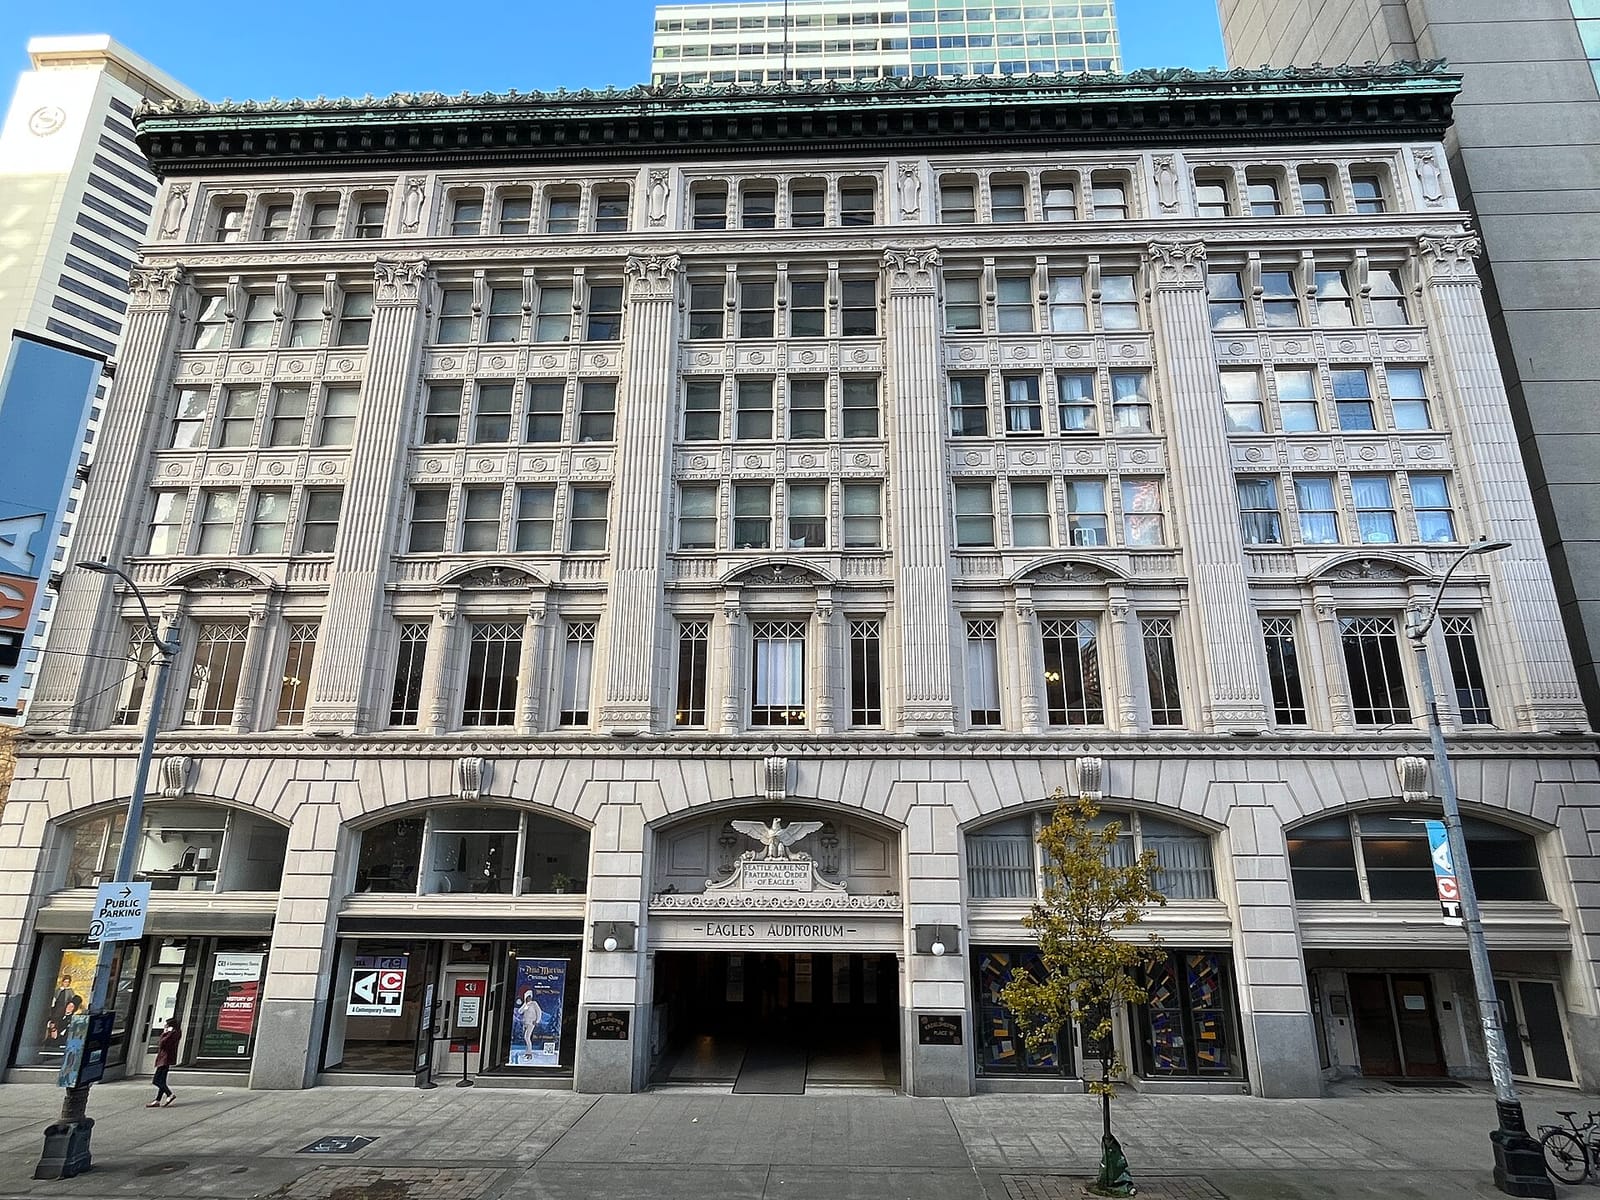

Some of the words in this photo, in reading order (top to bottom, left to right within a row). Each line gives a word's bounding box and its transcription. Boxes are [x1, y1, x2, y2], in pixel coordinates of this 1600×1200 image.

[105, 898, 140, 908] PUBLIC
[99, 908, 142, 918] PARKING
[706, 922, 755, 937] EAGLES
[767, 923, 844, 937] AUDITORIUM
[354, 971, 403, 1005] ACT
